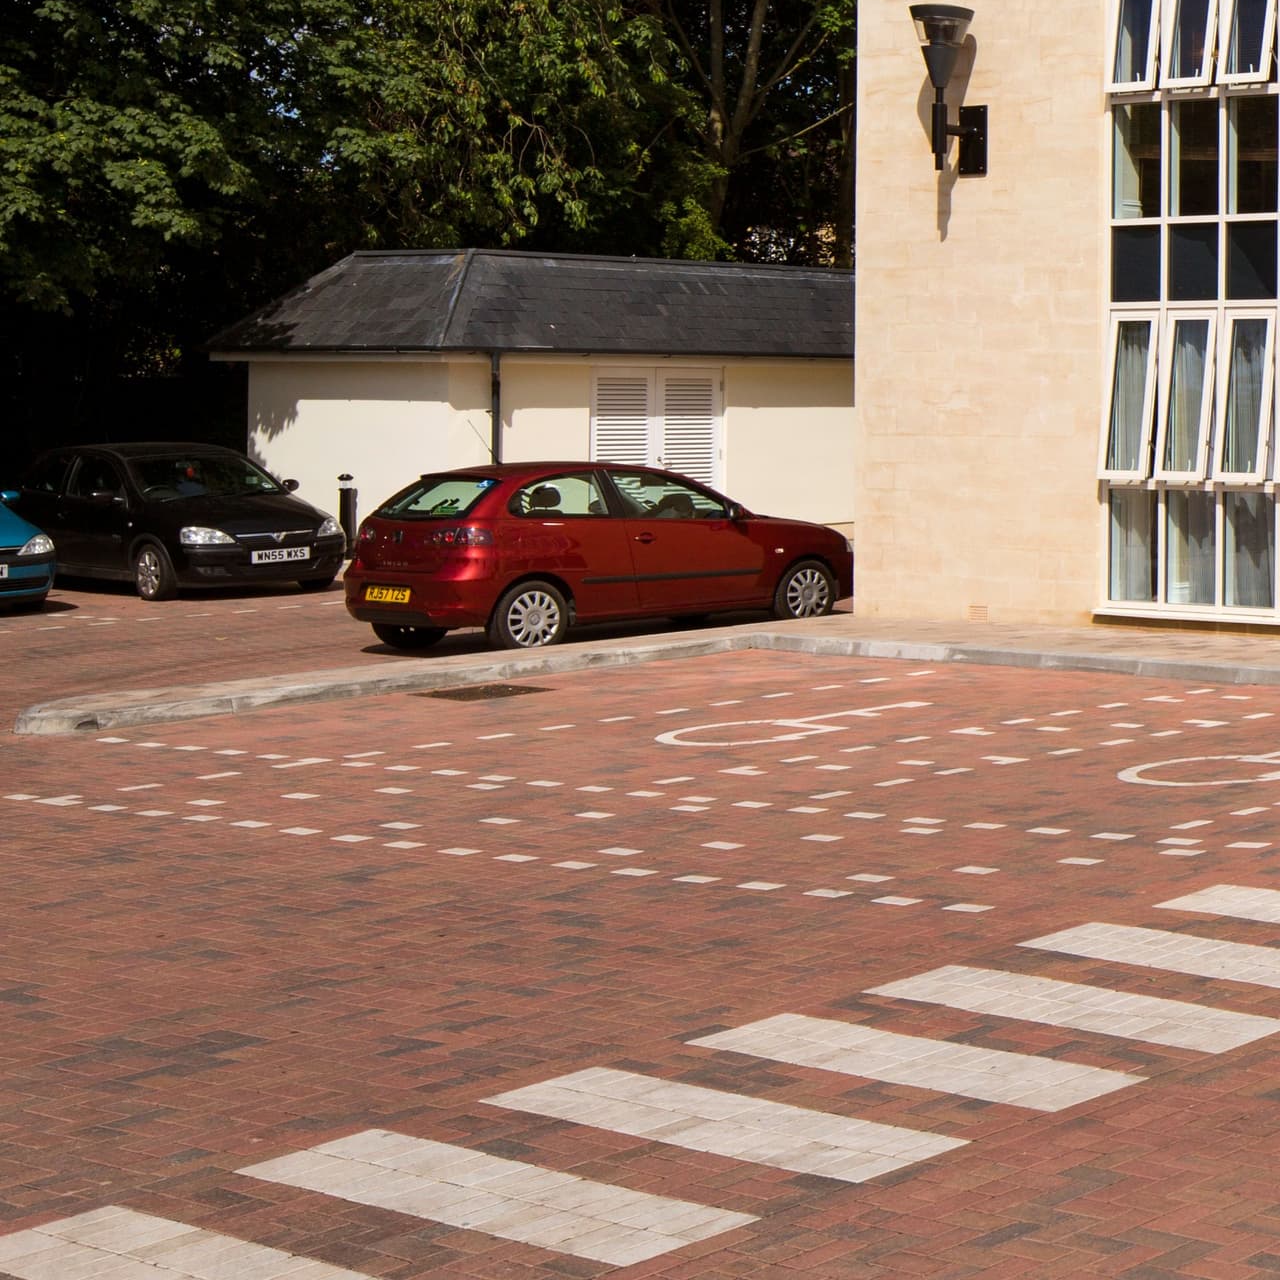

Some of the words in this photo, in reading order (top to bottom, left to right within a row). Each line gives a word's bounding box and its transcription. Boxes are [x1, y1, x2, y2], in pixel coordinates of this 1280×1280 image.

[257, 550, 284, 561] WN55
[286, 548, 305, 559] WXS
[368, 587, 389, 599] RJ57
